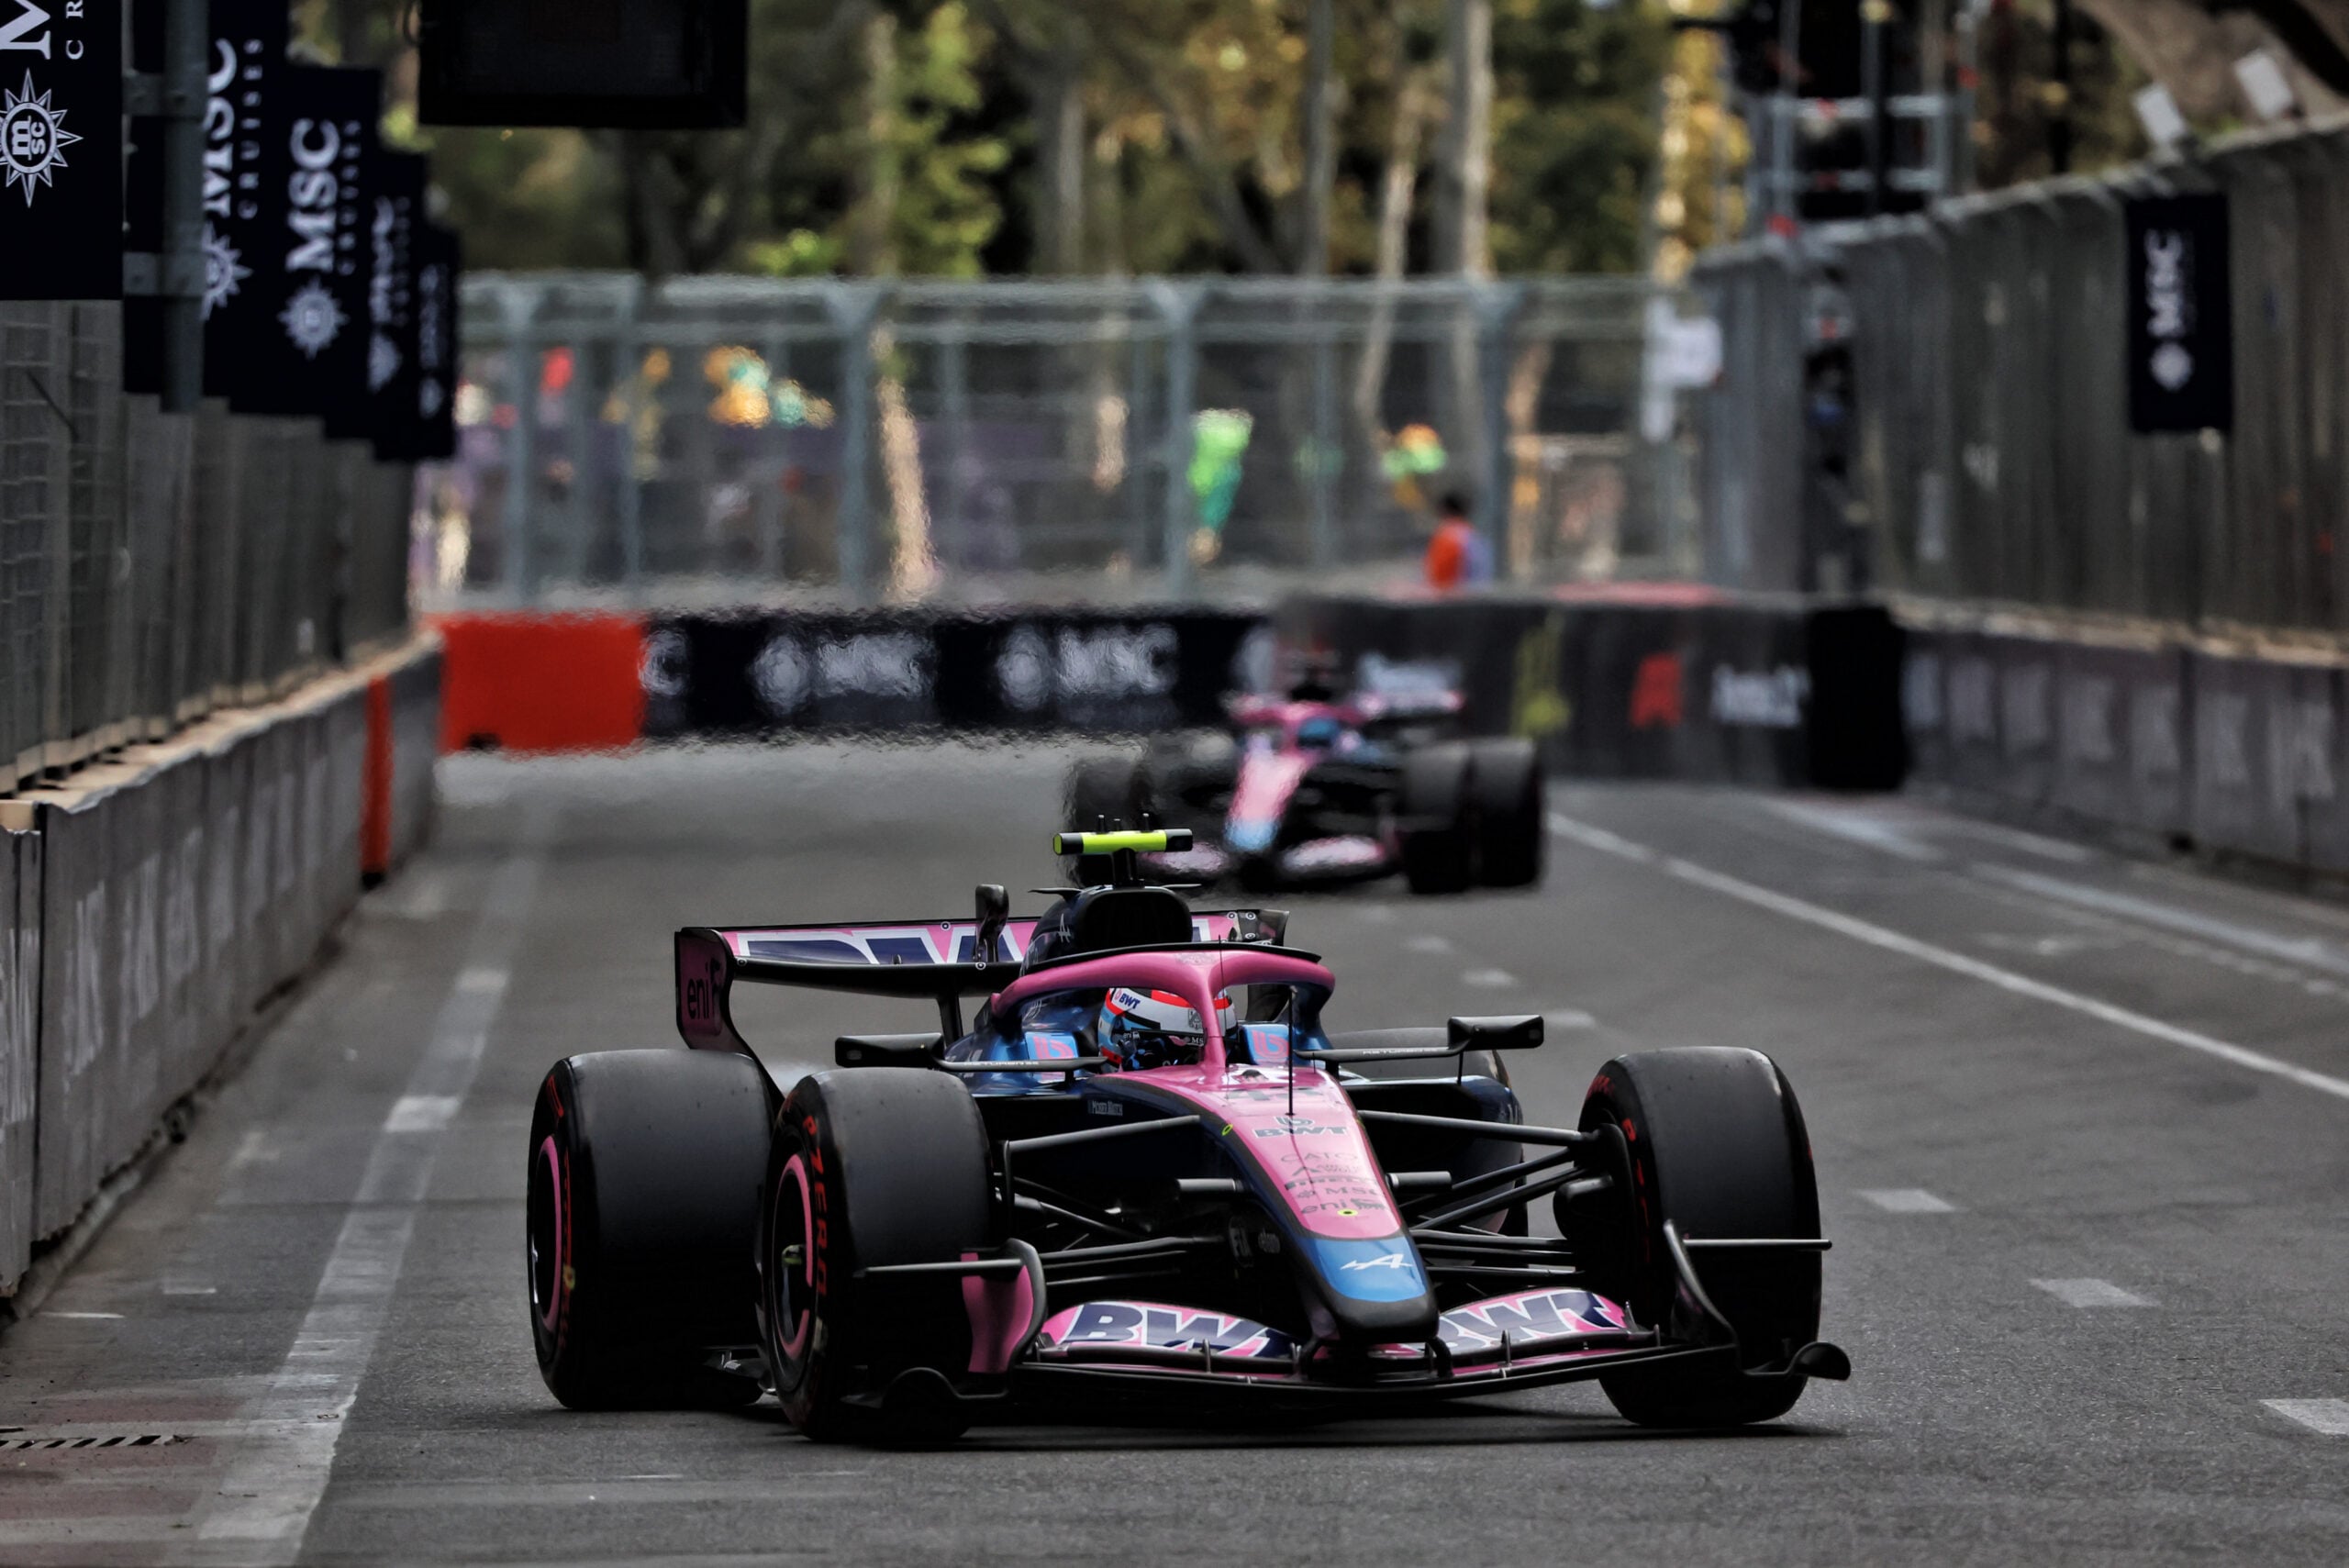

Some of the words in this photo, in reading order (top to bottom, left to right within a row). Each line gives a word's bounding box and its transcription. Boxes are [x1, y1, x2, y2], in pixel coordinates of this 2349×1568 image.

[285, 118, 340, 272] MSC
[687, 961, 710, 1019] eni
[1119, 994, 1141, 1009] BWT
[1254, 1126, 1346, 1138] BWT
[1301, 1199, 1347, 1213] eni
